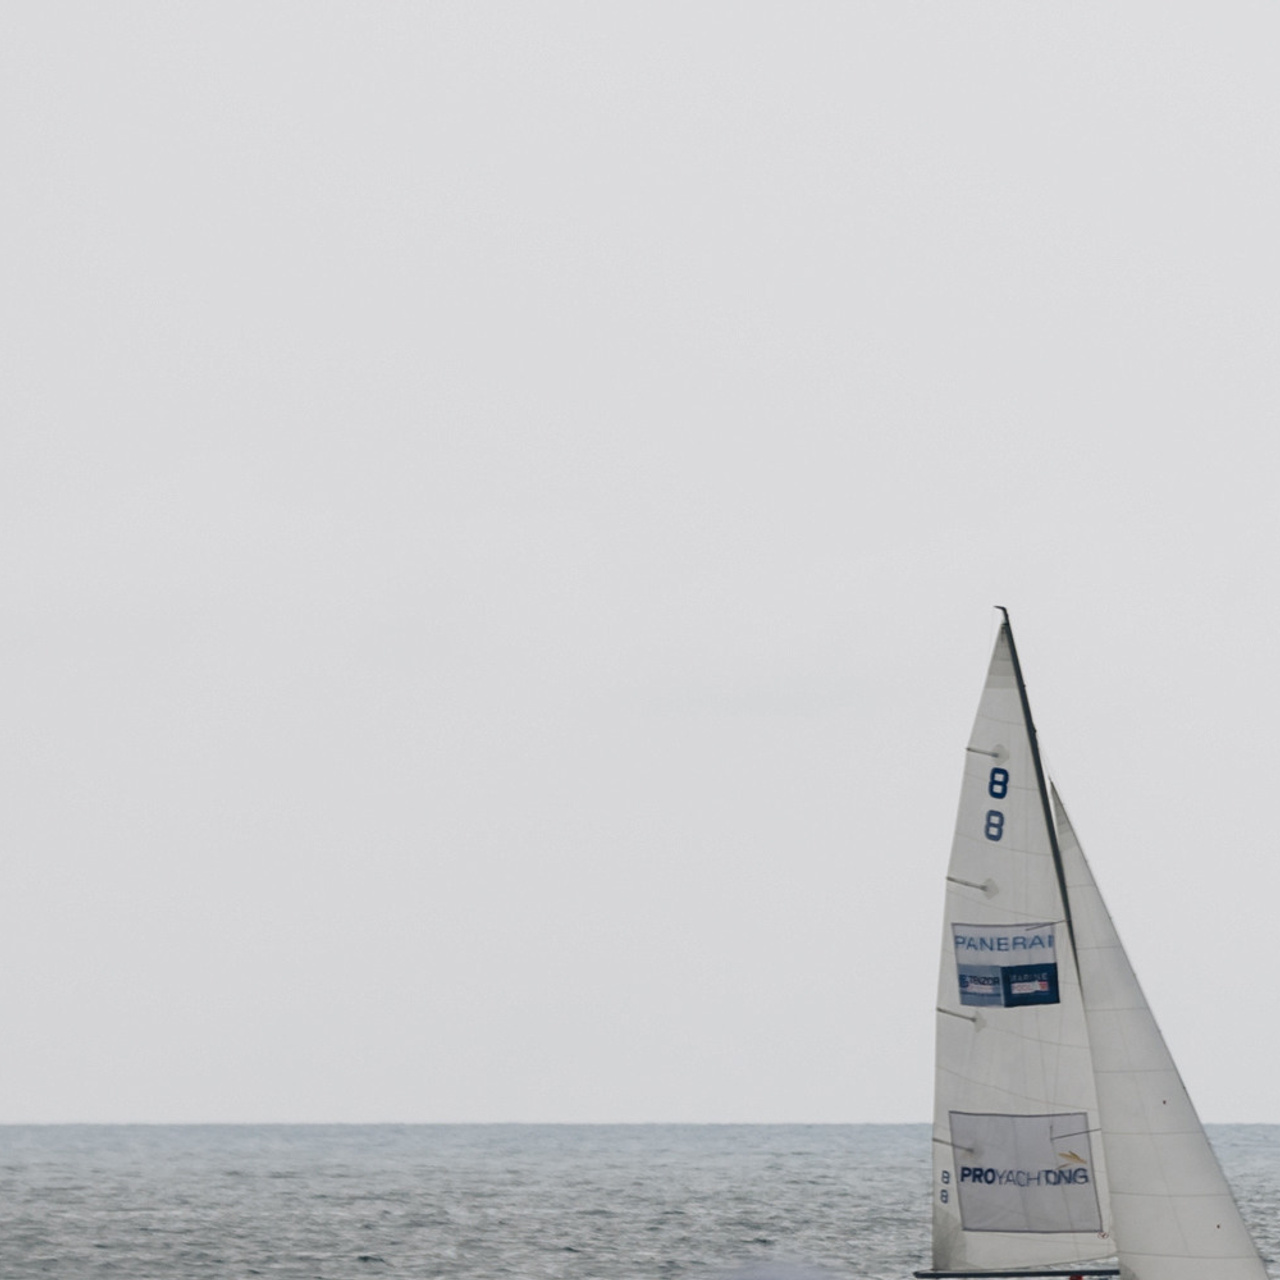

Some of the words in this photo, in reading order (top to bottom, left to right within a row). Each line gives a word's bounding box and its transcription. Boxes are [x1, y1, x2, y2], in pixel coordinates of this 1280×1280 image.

[988, 767, 1009, 799] 8
[984, 810, 1005, 841] 8
[954, 934, 1055, 951] PANERAI
[960, 1166, 1090, 1187] PROYACHTING
